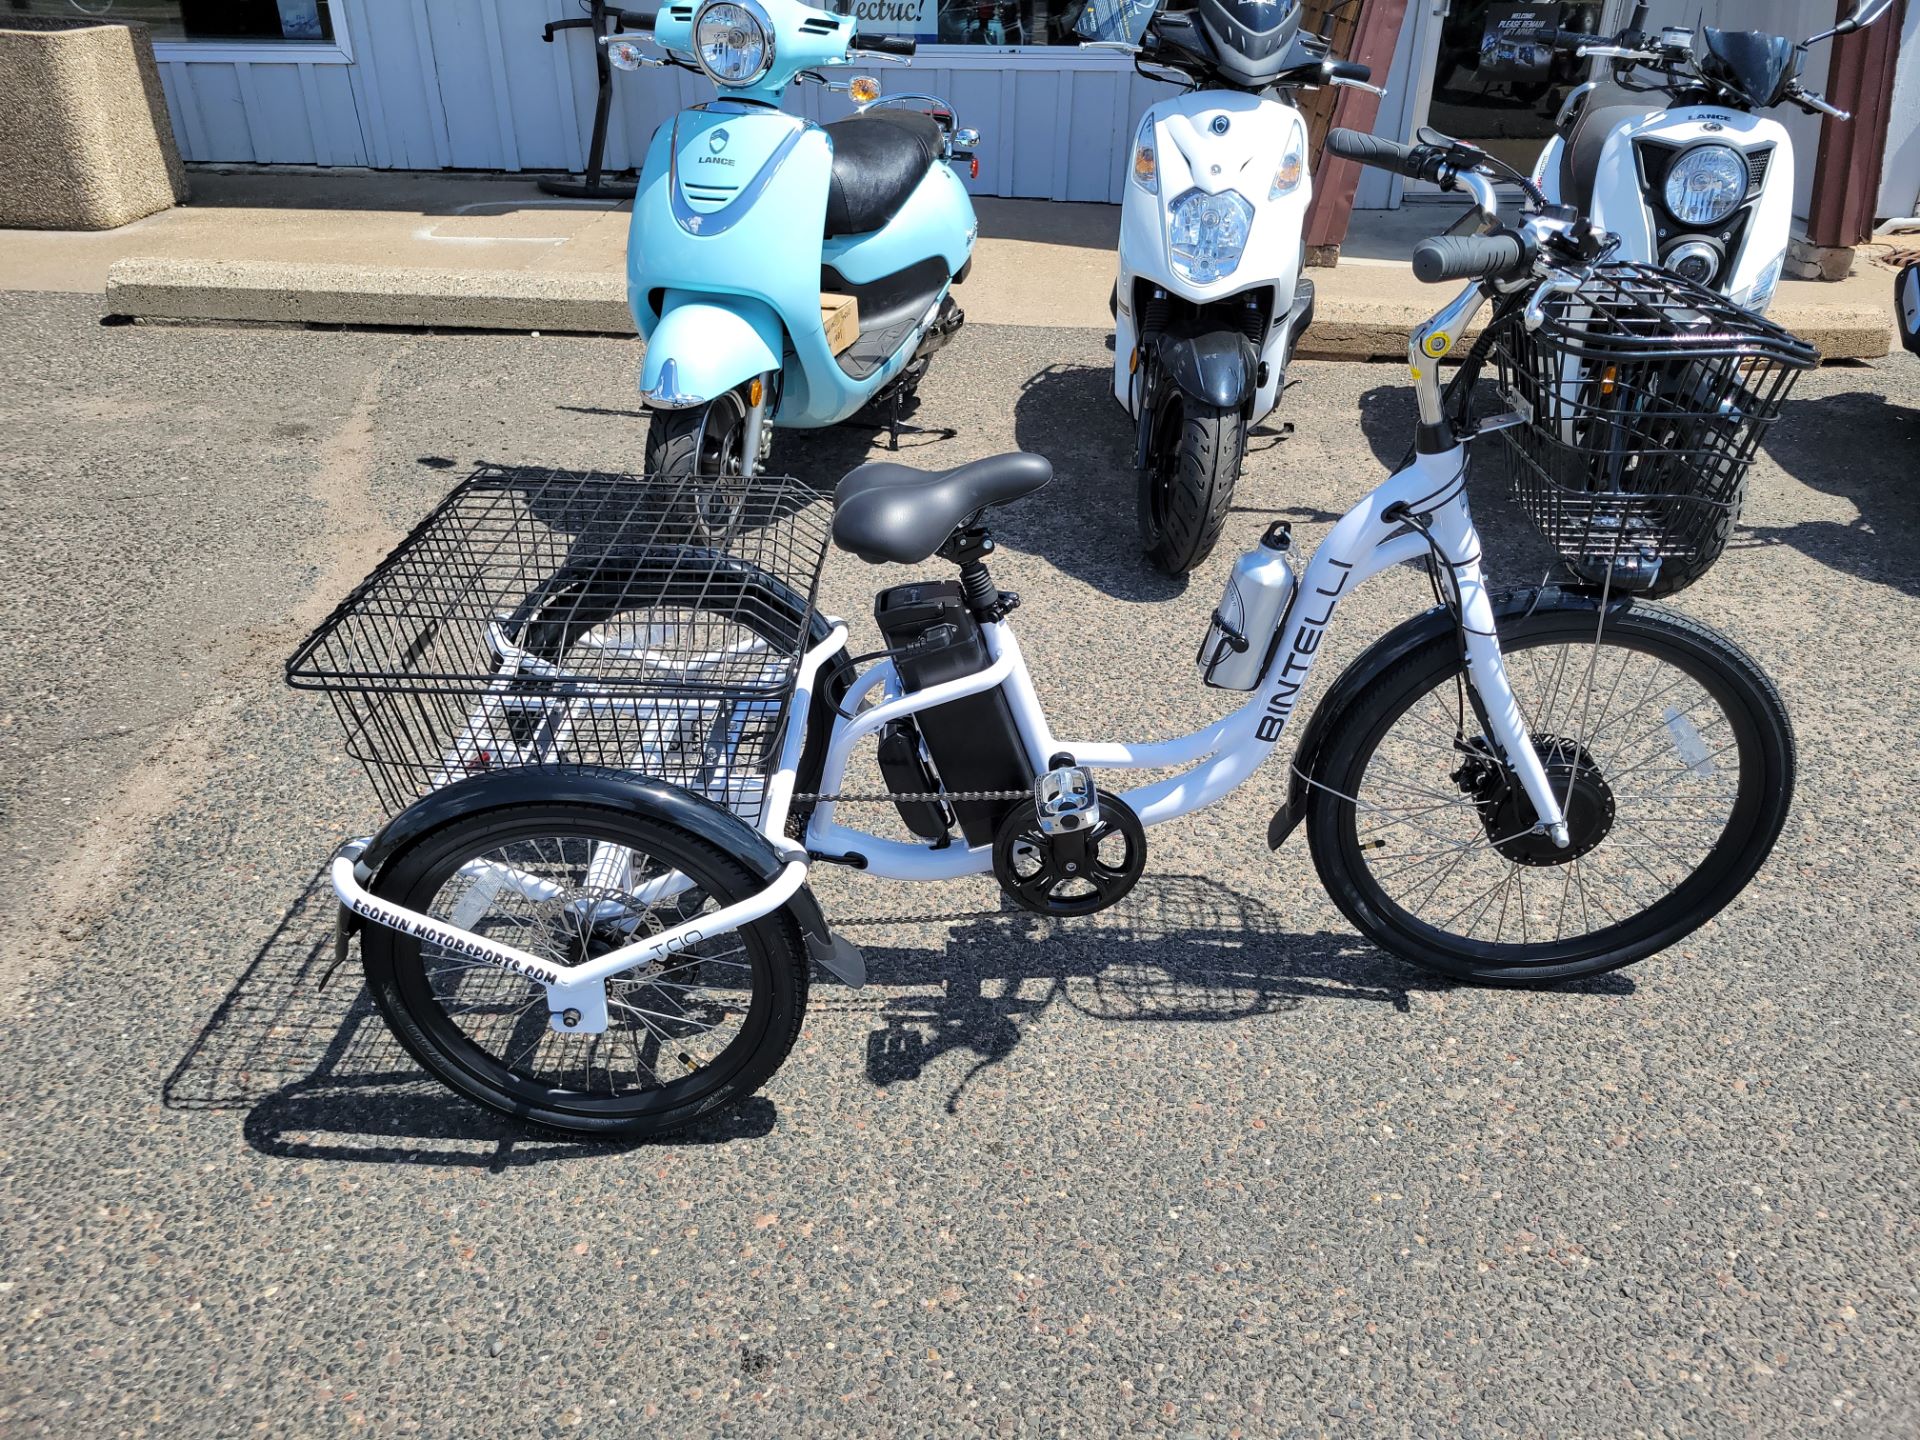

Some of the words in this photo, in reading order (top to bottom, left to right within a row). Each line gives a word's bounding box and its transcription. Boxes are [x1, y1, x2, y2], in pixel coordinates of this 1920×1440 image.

[1498, 20, 1522, 28] PLEASE
[698, 157, 735, 166] LANCE
[1254, 557, 1353, 743] BINTELLI
[352, 898, 411, 932] ECOFUN
[413, 923, 558, 986] MOTORSPORTS.COM
